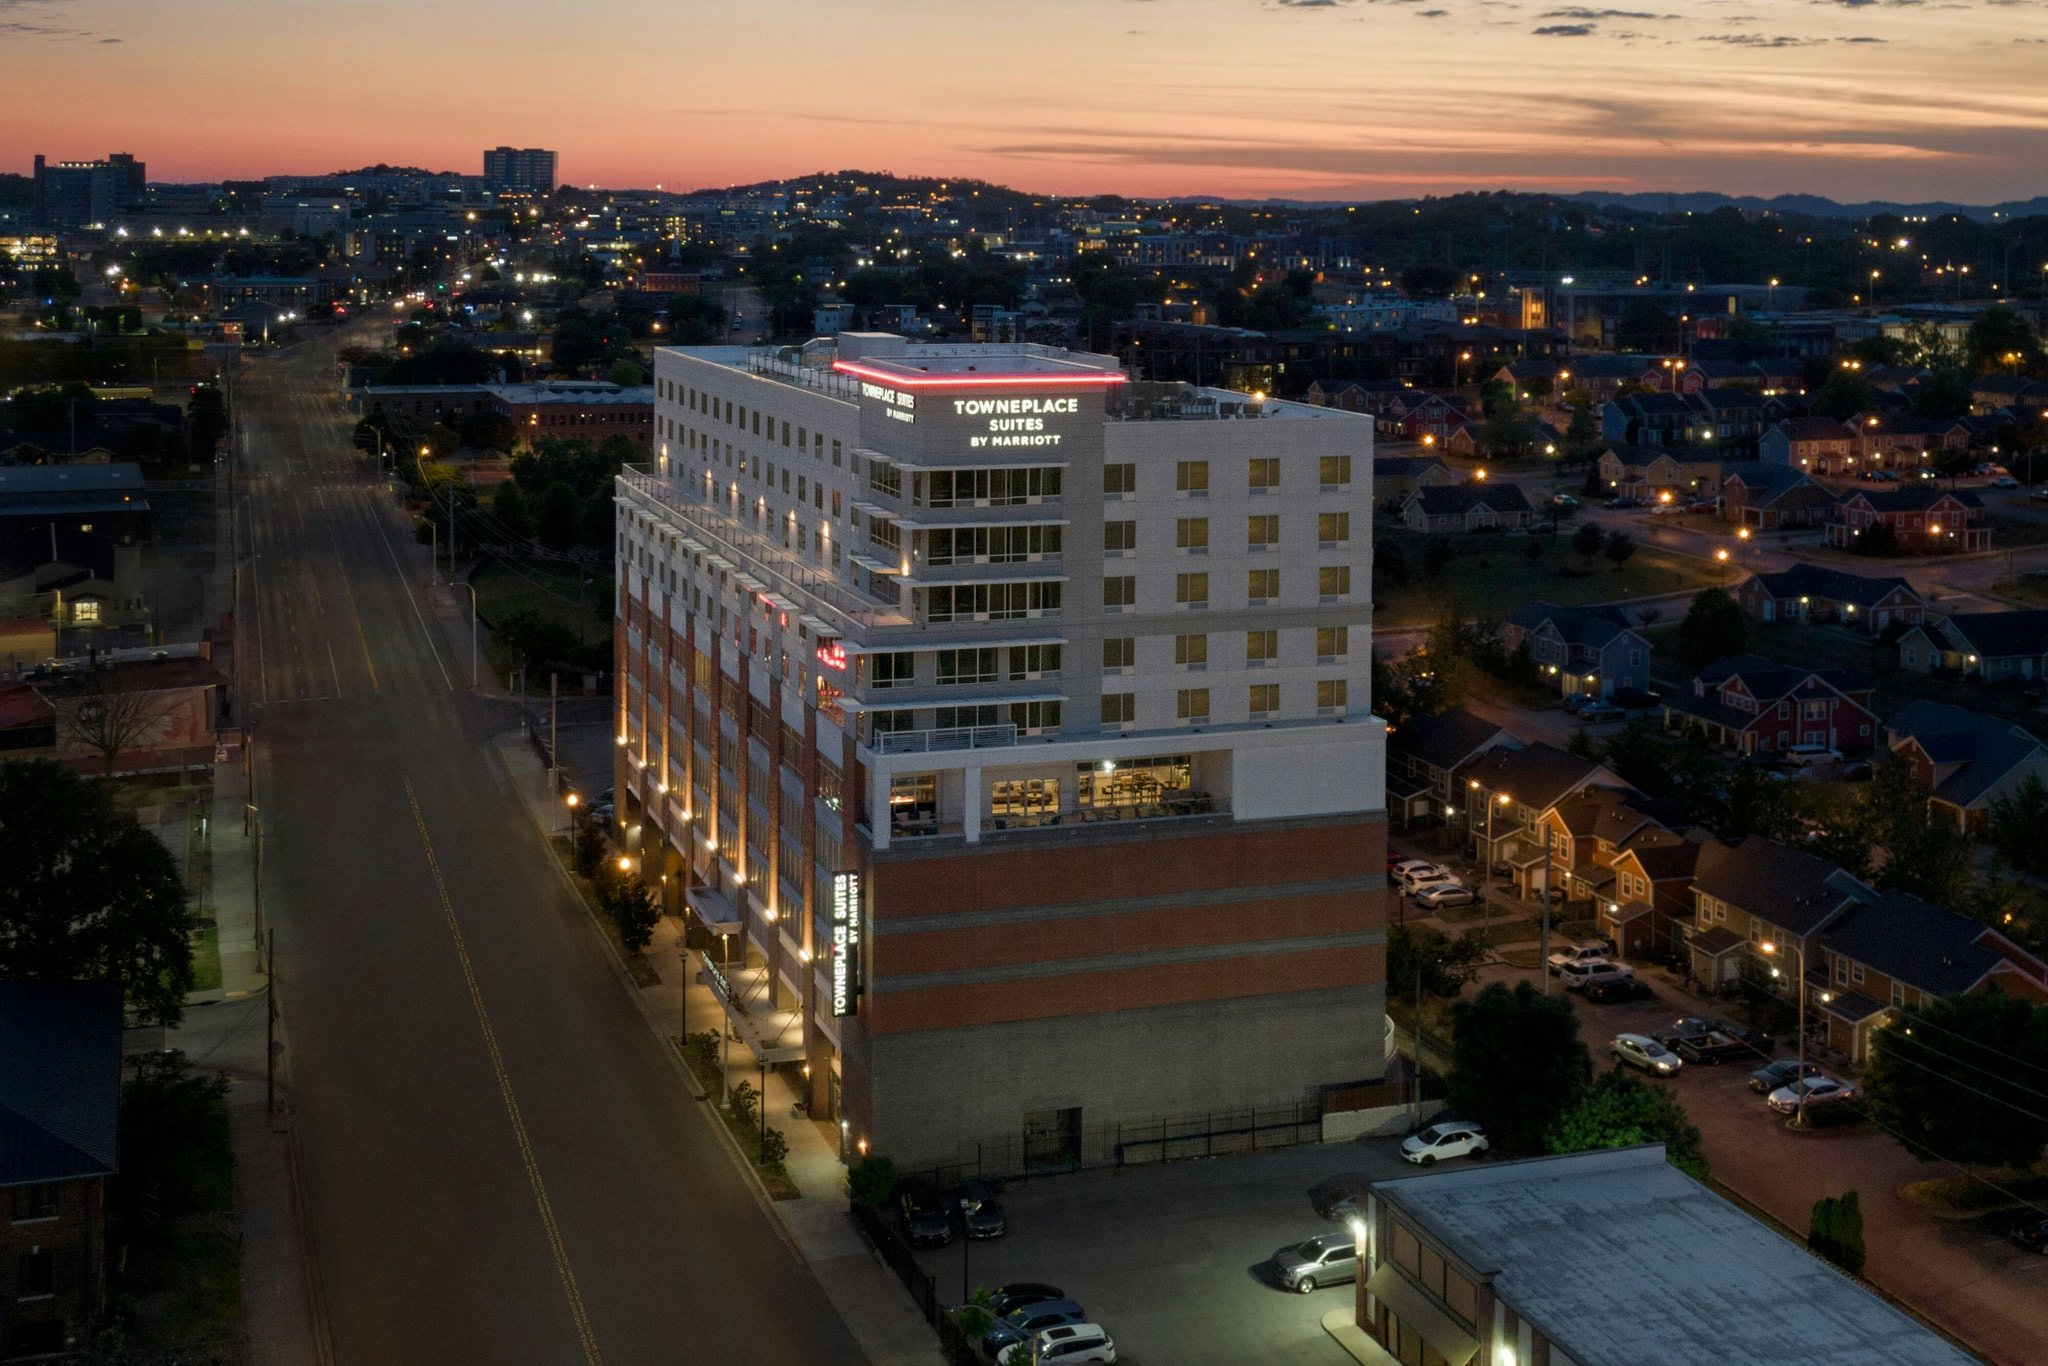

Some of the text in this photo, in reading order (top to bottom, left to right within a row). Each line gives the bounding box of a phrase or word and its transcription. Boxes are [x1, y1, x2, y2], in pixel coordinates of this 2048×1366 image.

[897, 392, 914, 409] SUITES
[954, 398, 1078, 414] TOWNEPLACE
[989, 418, 1043, 431] SUITES
[970, 435, 1061, 447] BY MARRIOTT
[849, 874, 858, 943] BY MARRIOTT
[834, 874, 847, 1016] TOWNEPLACE SUITES
